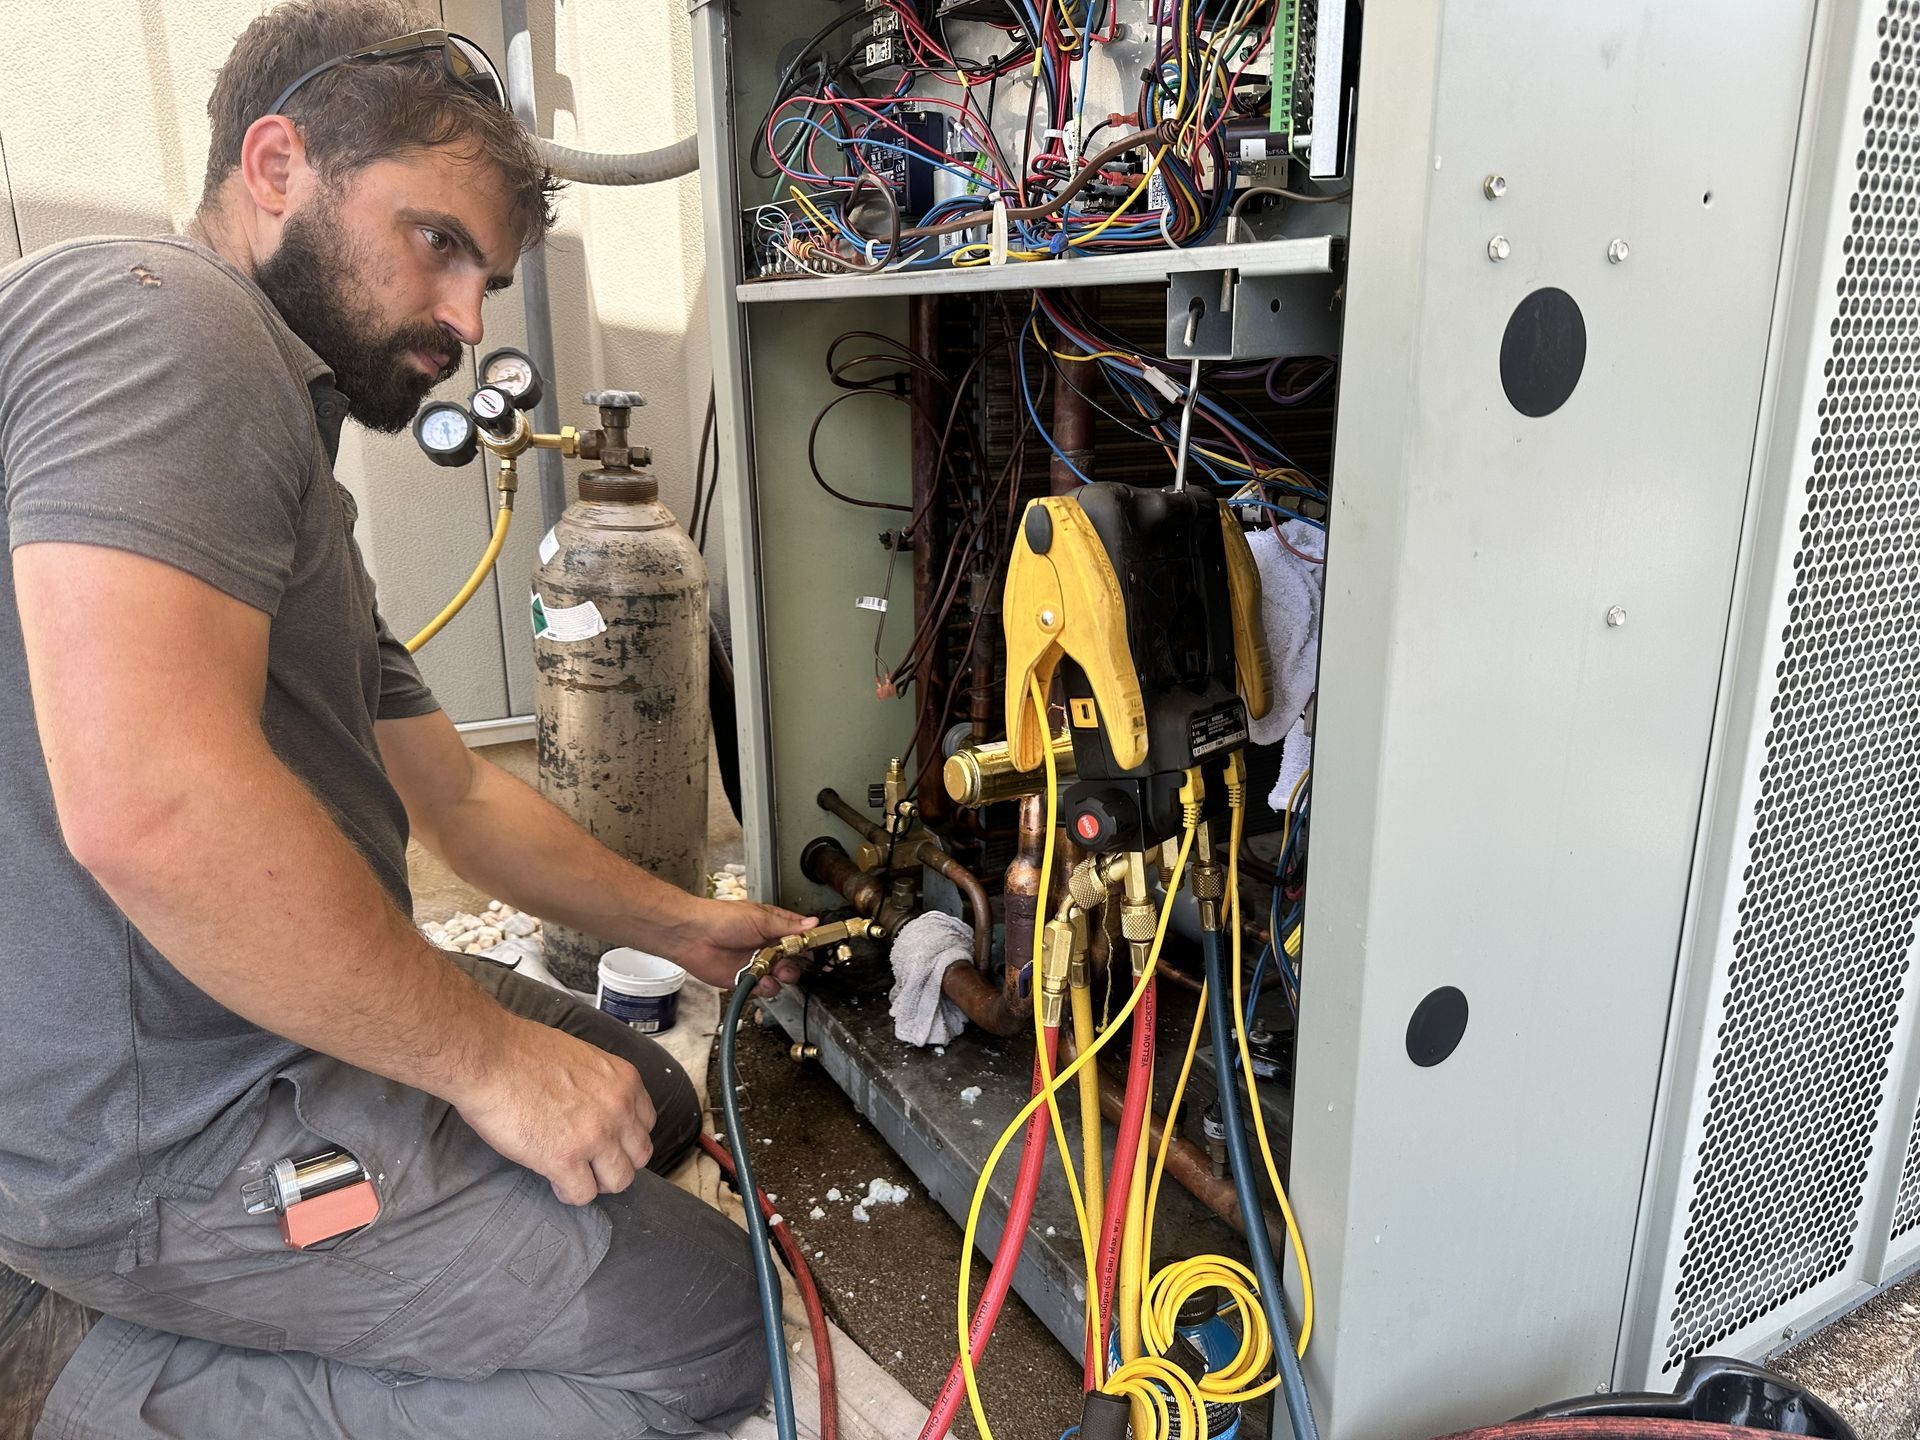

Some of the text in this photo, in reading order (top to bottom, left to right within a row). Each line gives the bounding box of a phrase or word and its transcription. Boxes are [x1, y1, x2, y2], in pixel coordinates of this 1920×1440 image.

[1081, 816, 1095, 837] HIGH
[1141, 1033, 1151, 1067] YELLOW
[1105, 1255, 1115, 1273] Bar)
[1103, 1276, 1112, 1290] (55
[972, 1300, 990, 1335] YELLOW
[946, 1375, 958, 1393] Plus
